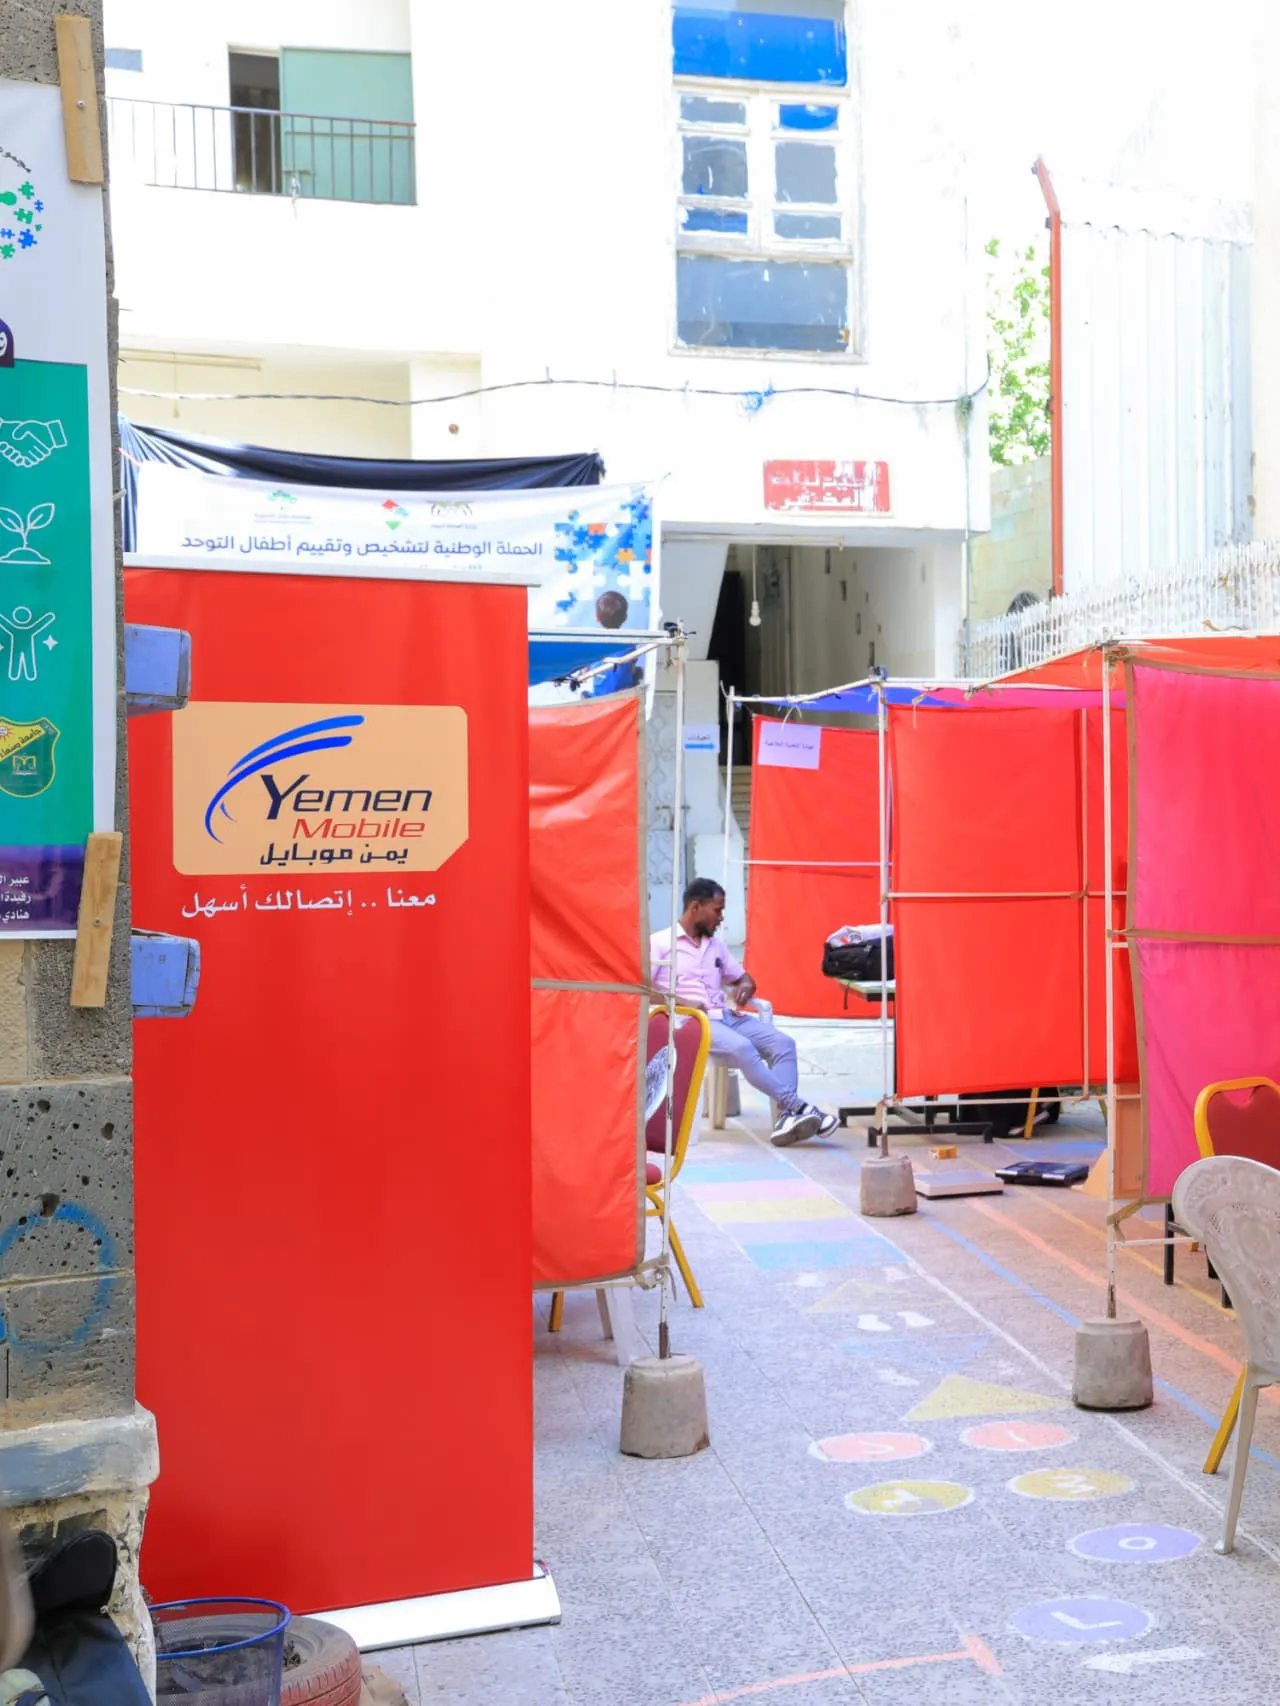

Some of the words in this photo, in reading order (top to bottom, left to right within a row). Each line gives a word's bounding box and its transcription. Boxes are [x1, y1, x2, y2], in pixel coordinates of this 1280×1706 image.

[180, 535, 235, 552] التوحد
[239, 534, 292, 554] أطفال
[296, 538, 352, 557] وتقييم
[356, 539, 430, 557] لتشخيص
[433, 540, 492, 558] الوطنية
[496, 541, 543, 556] الحملة
[260, 774, 433, 820] Yemen
[292, 817, 426, 839] Mobile
[259, 842, 353, 866] موبايل
[359, 843, 409, 865] يمن
[181, 883, 248, 919] أسهل
[254, 889, 354, 916] إتصالك
[385, 887, 437, 908] معنا
